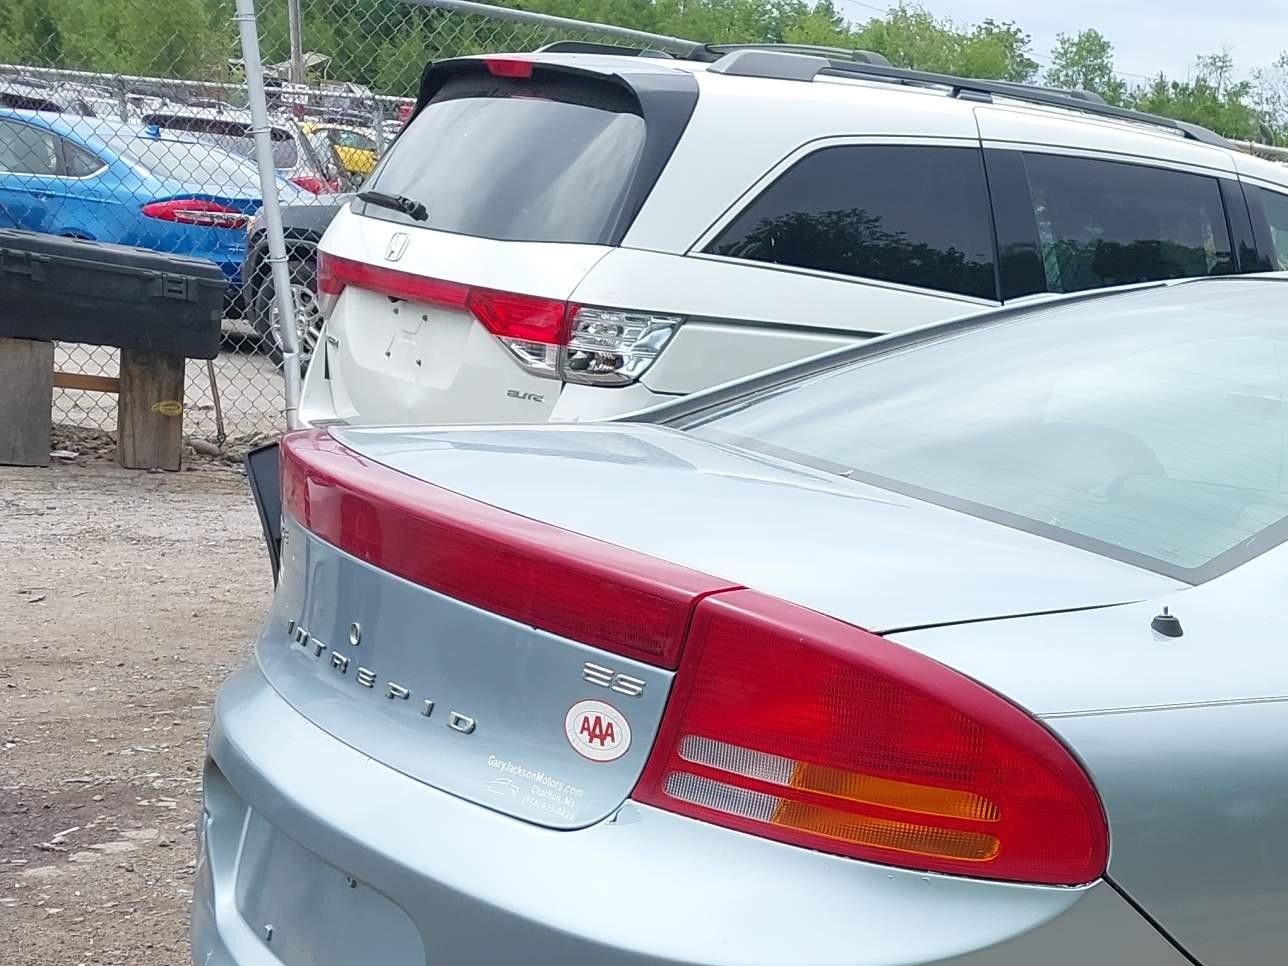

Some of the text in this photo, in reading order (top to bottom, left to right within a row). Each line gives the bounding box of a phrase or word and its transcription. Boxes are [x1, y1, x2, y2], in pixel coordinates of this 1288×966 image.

[287, 619, 477, 735] INTREPID
[583, 661, 646, 697] ES
[580, 715, 616, 747] AAA
[487, 754, 584, 799] GaryJacksonMotors.com
